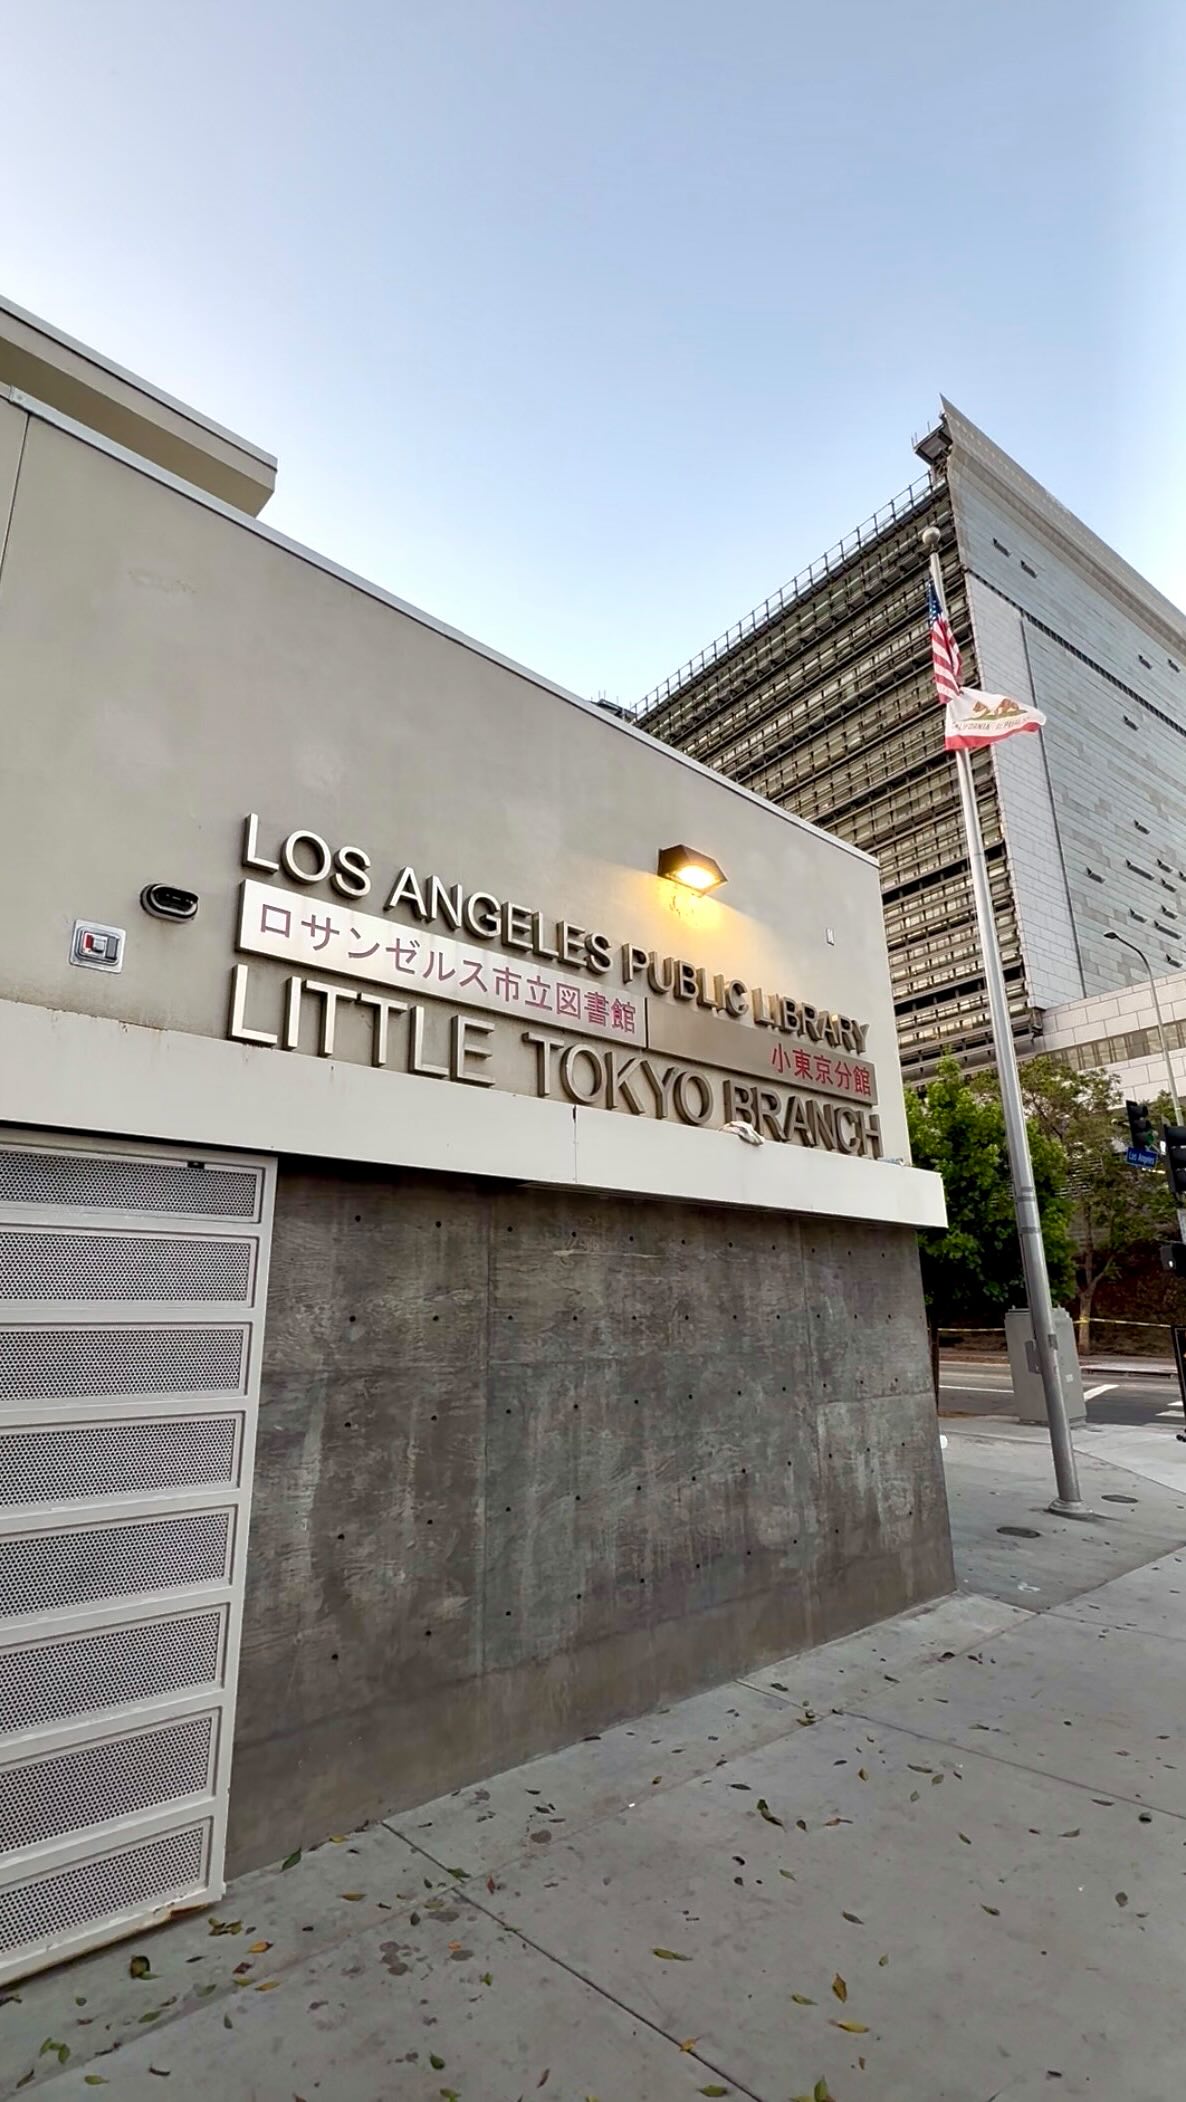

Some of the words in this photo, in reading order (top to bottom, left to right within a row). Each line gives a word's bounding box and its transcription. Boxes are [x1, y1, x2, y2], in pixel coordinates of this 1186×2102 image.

[242, 813, 372, 901] LOS
[383, 866, 613, 975] ANGELES
[622, 943, 748, 1018] PUBLIC
[752, 987, 871, 1056] LIBRARY
[260, 903, 637, 1036] ロサンゼルス市立図書館
[771, 1042, 873, 1098] 小東京分館
[228, 963, 496, 1089] LITTLE
[521, 1031, 713, 1126] TOKYO
[722, 1078, 884, 1161] BRANCH
